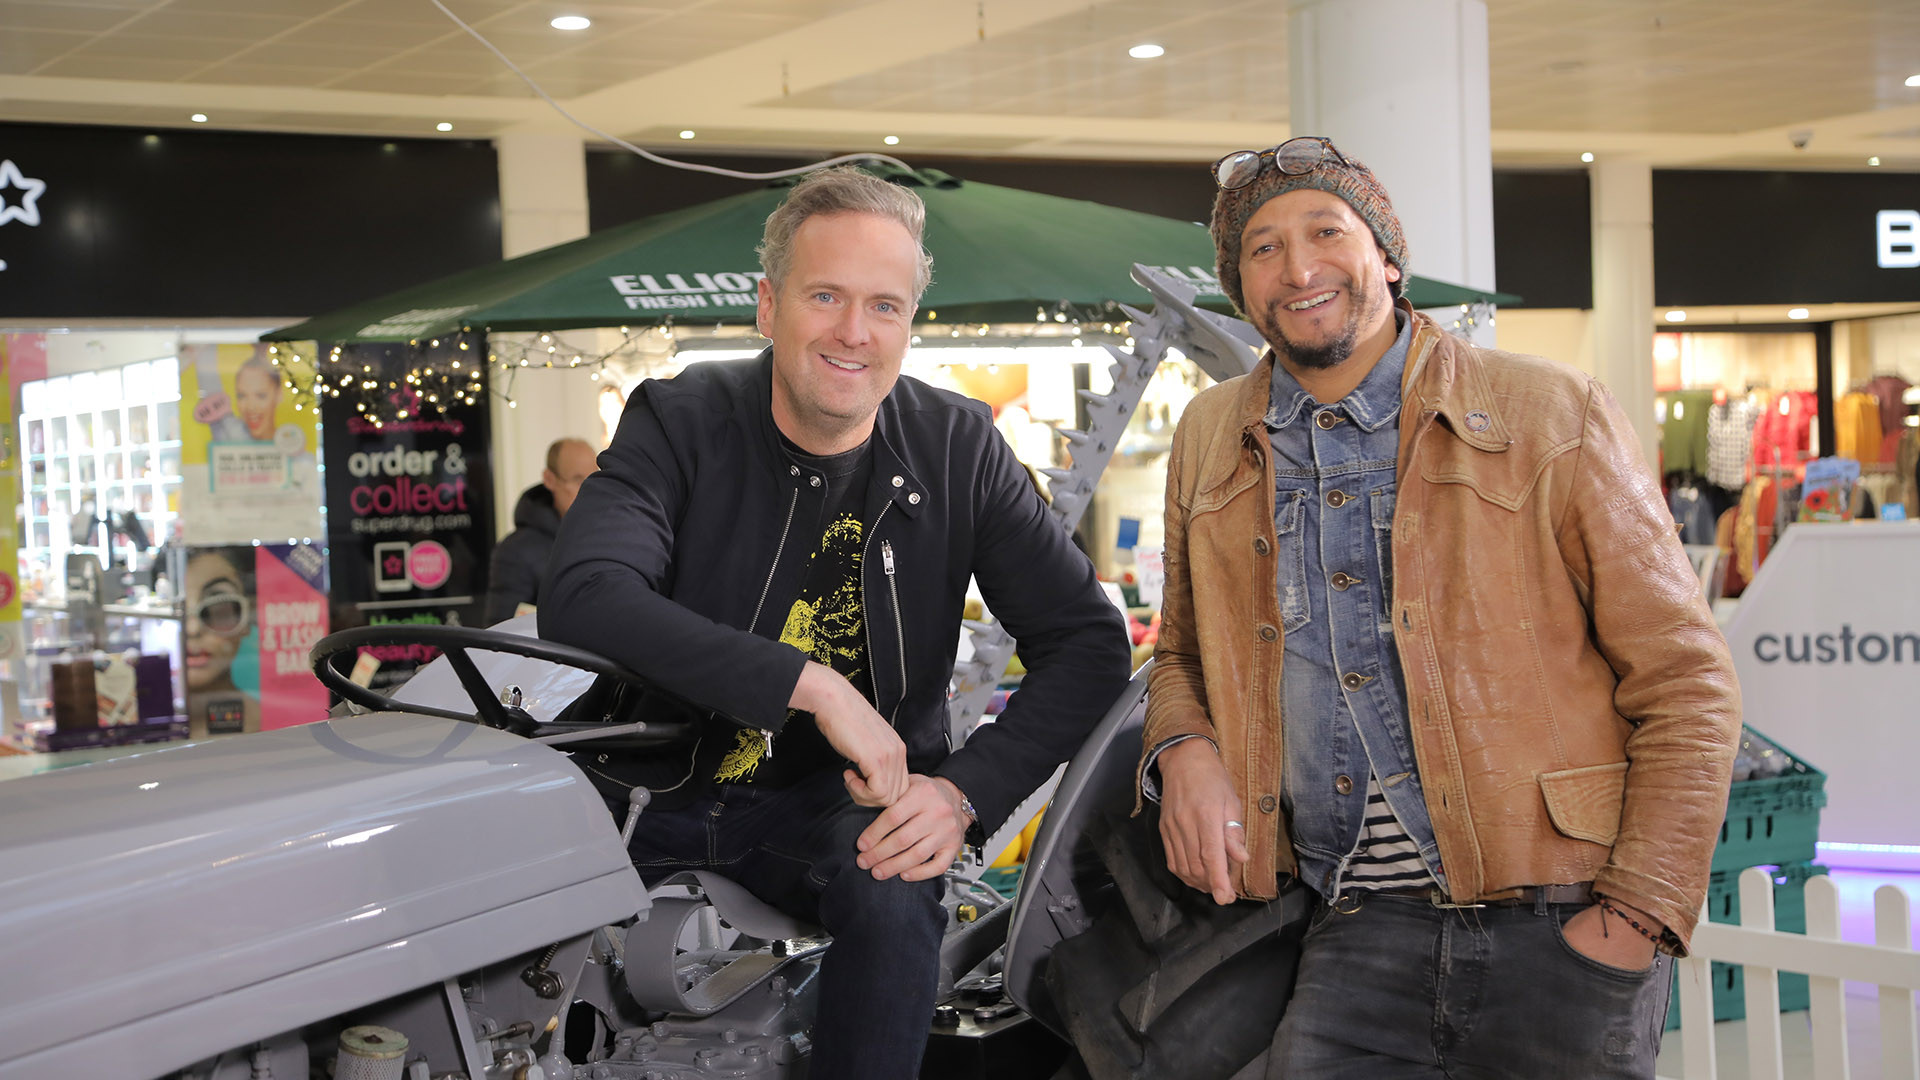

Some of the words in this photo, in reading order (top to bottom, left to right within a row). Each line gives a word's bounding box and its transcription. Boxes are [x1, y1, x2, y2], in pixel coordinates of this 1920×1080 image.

[1876, 209, 1920, 268] B
[624, 294, 708, 310] FRESH
[348, 444, 438, 477] order
[443, 443, 467, 475] &
[350, 476, 467, 515] collect
[265, 602, 320, 626] BROW
